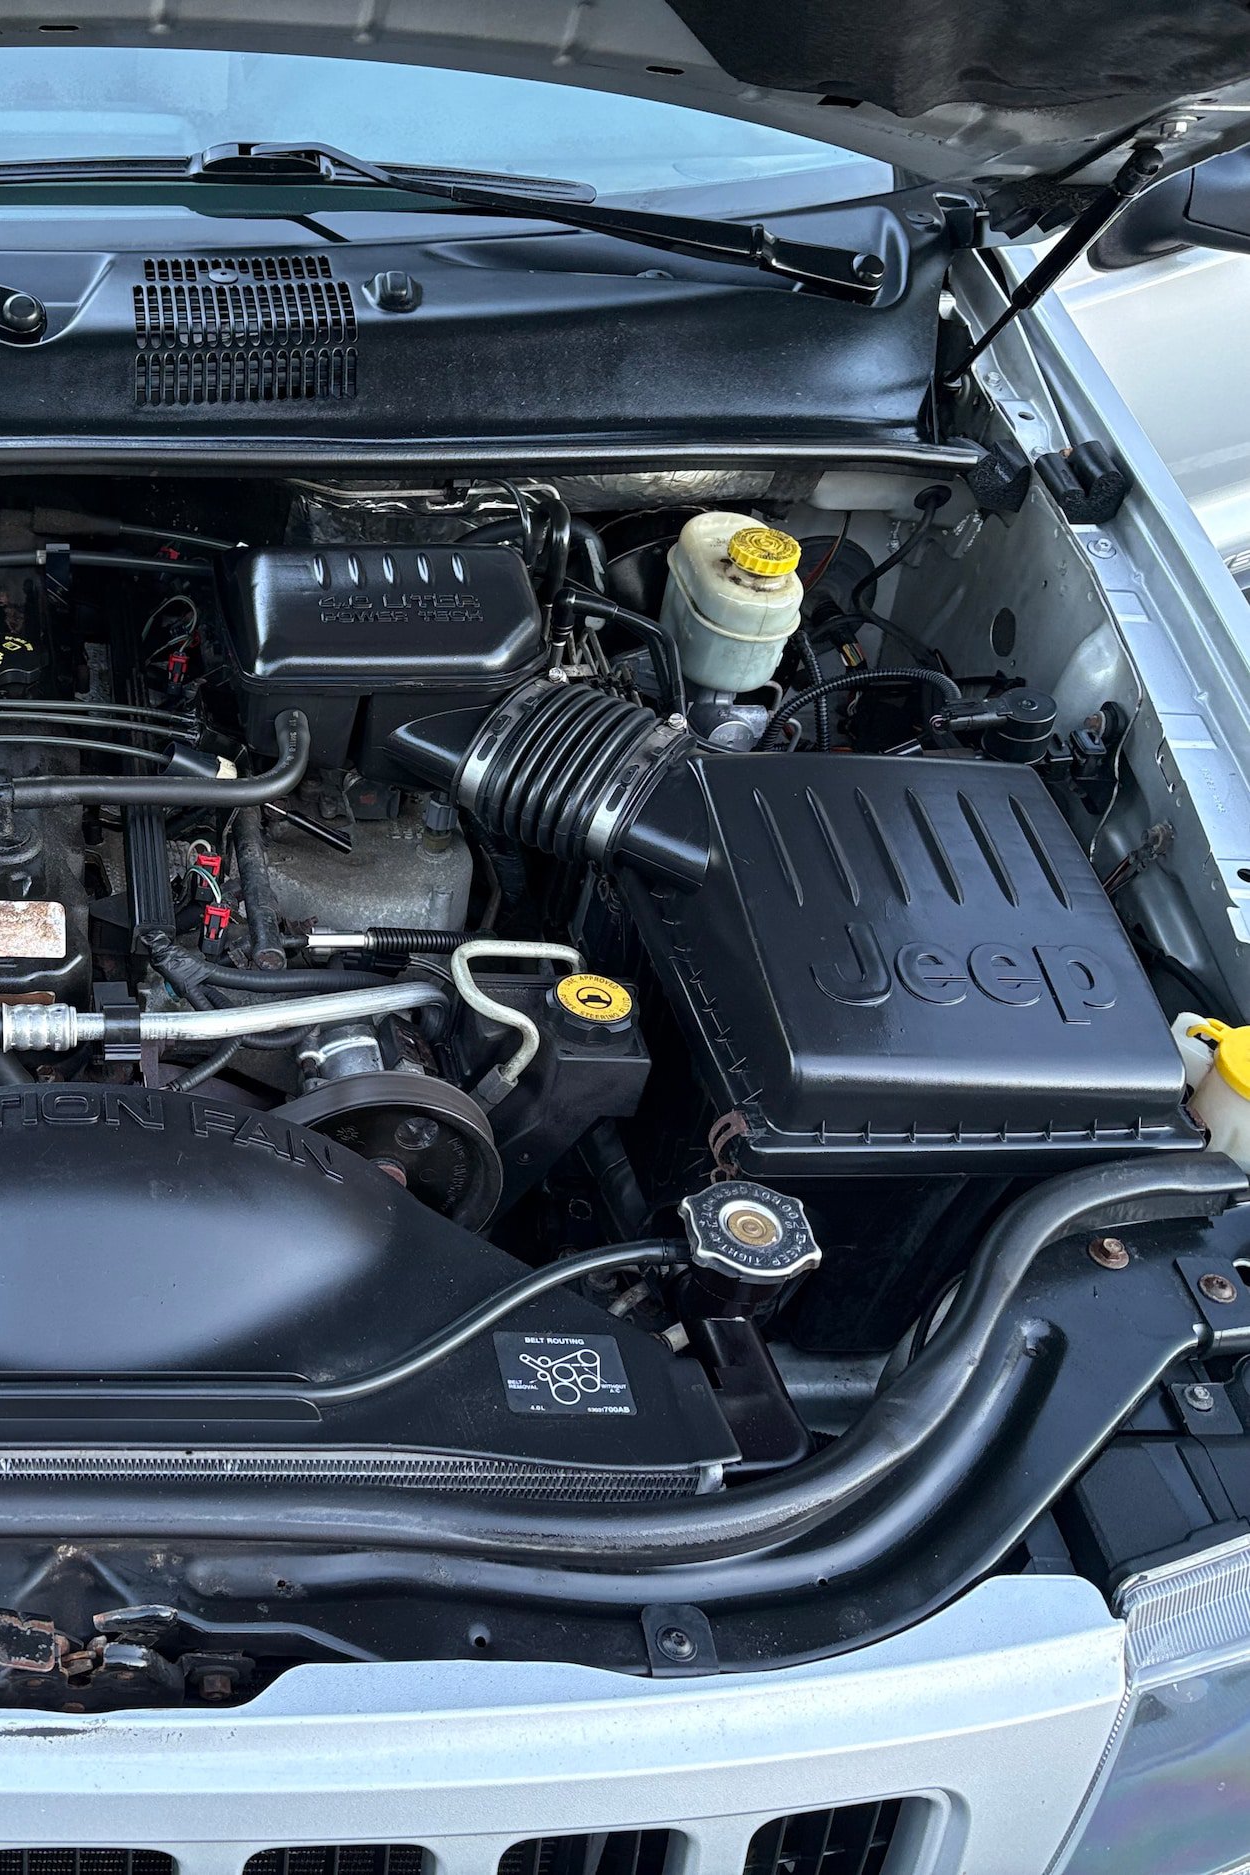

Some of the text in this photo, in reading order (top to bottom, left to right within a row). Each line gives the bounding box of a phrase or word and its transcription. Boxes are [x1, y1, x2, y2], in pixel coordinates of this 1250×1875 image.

[382, 593, 481, 609] LITER
[320, 610, 484, 623] POWER TECH
[809, 922, 1118, 1025] Jeep
[579, 975, 619, 990] APPROVED
[580, 1010, 620, 1020] STEERING
[190, 1101, 344, 1184] FAN
[719, 1244, 762, 1266] TIGHT
[547, 1337, 585, 1345] ROUTING
